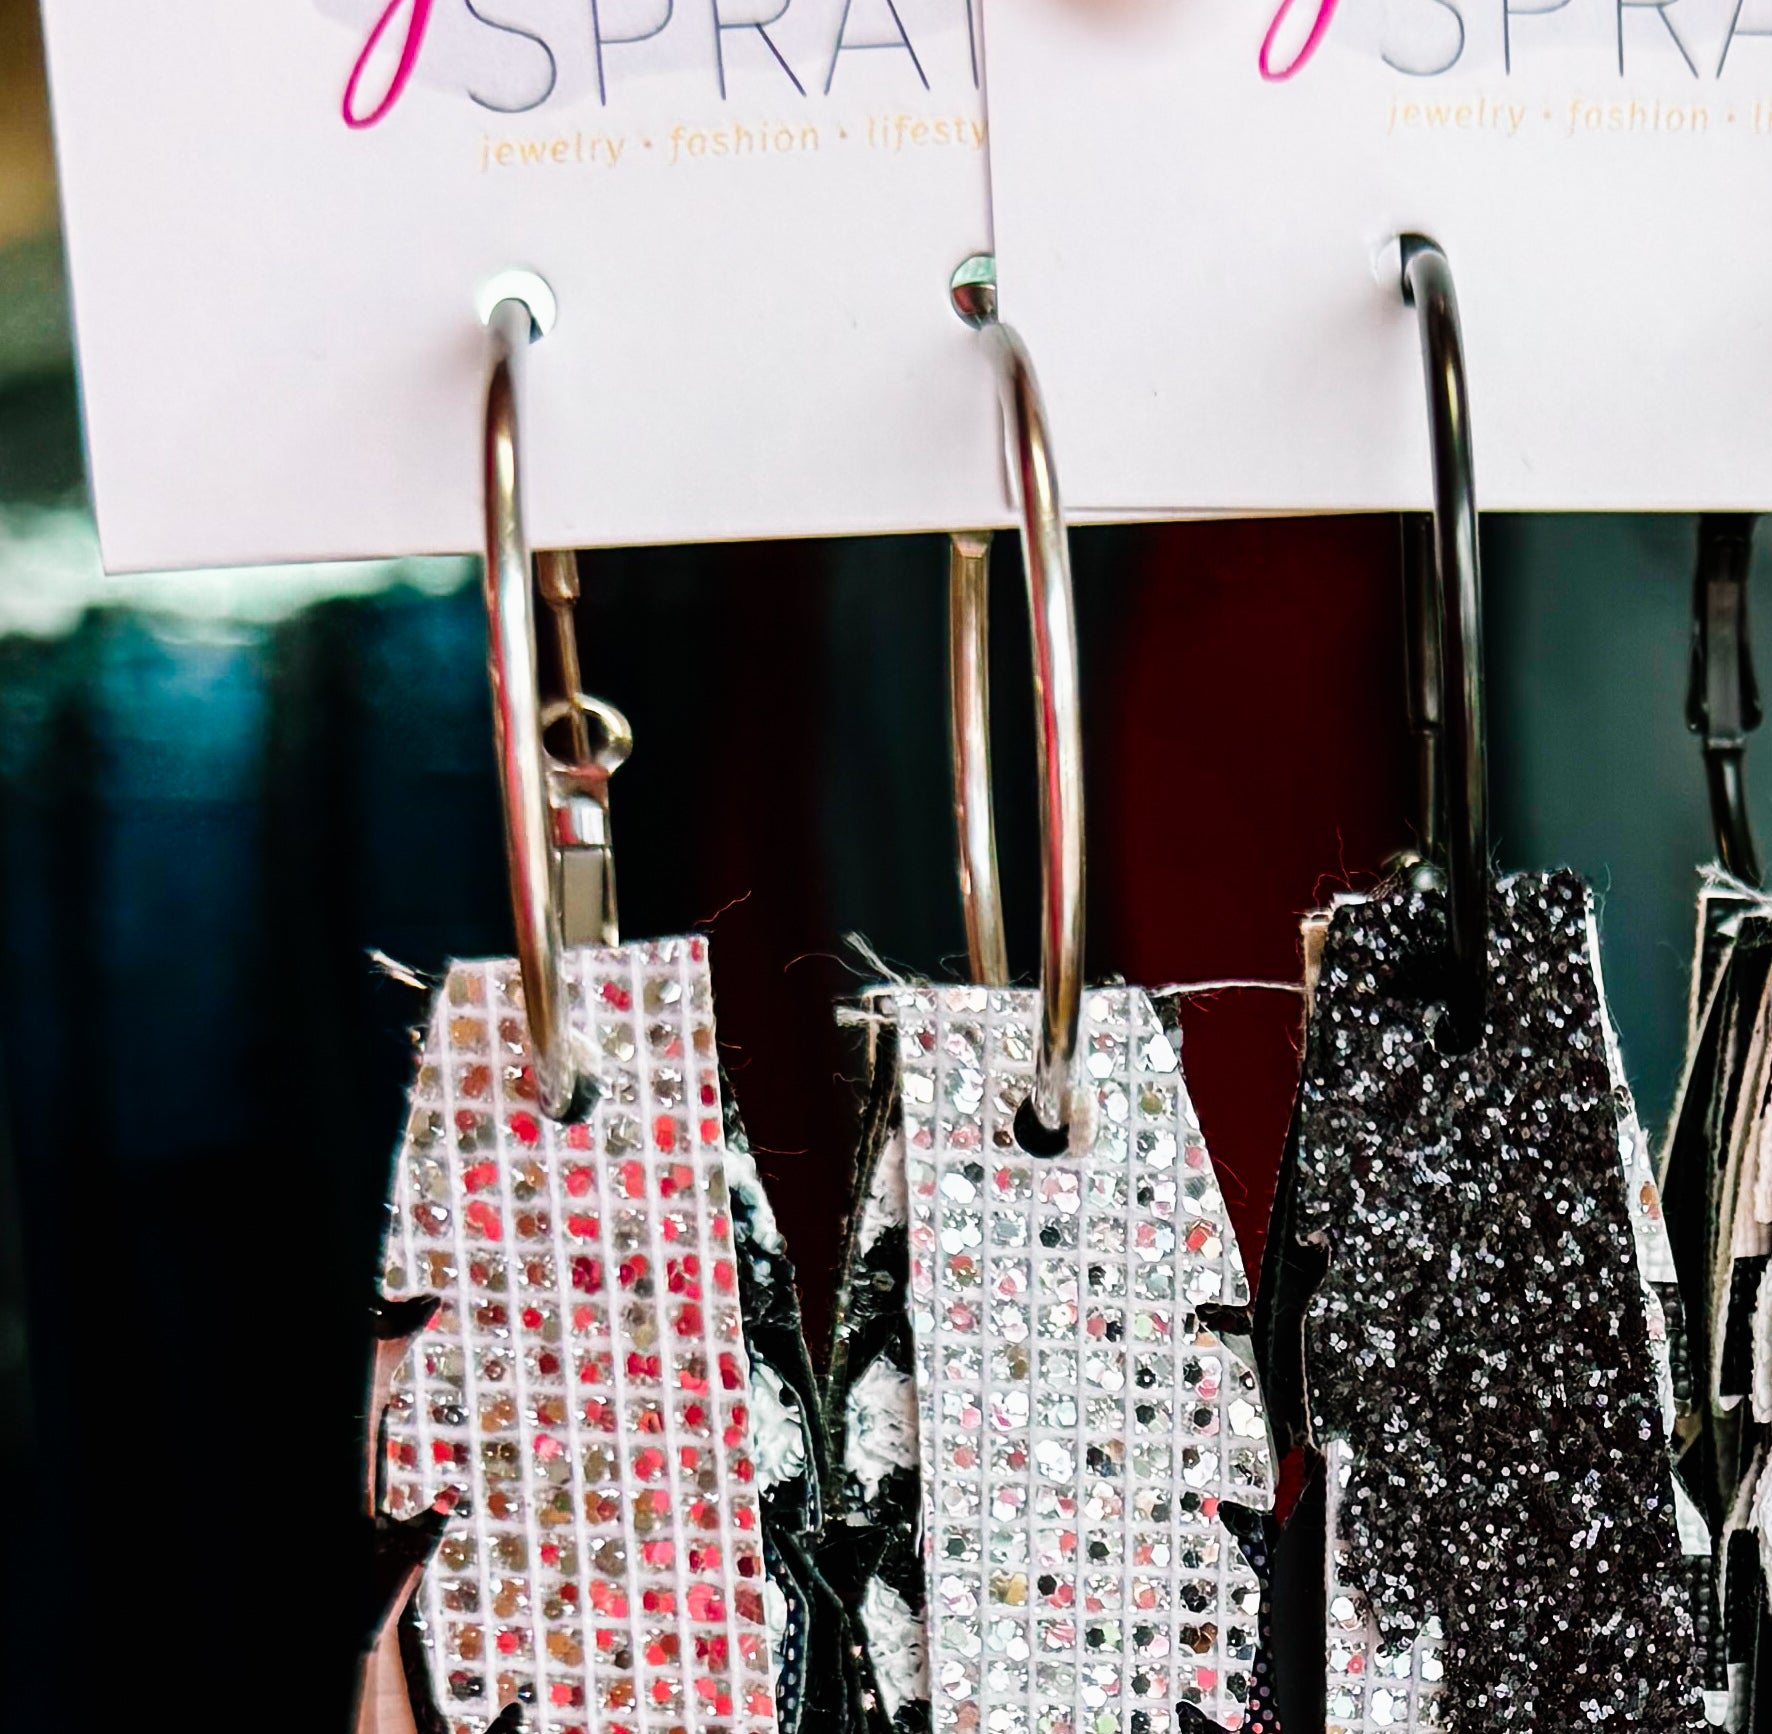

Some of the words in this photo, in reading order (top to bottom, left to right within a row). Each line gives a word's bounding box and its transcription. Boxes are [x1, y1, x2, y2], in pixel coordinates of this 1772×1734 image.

[1386, 97, 1526, 136] jewelry
[1565, 97, 1710, 136] fashion
[480, 128, 625, 172] jewelry
[668, 124, 820, 162] fashion
